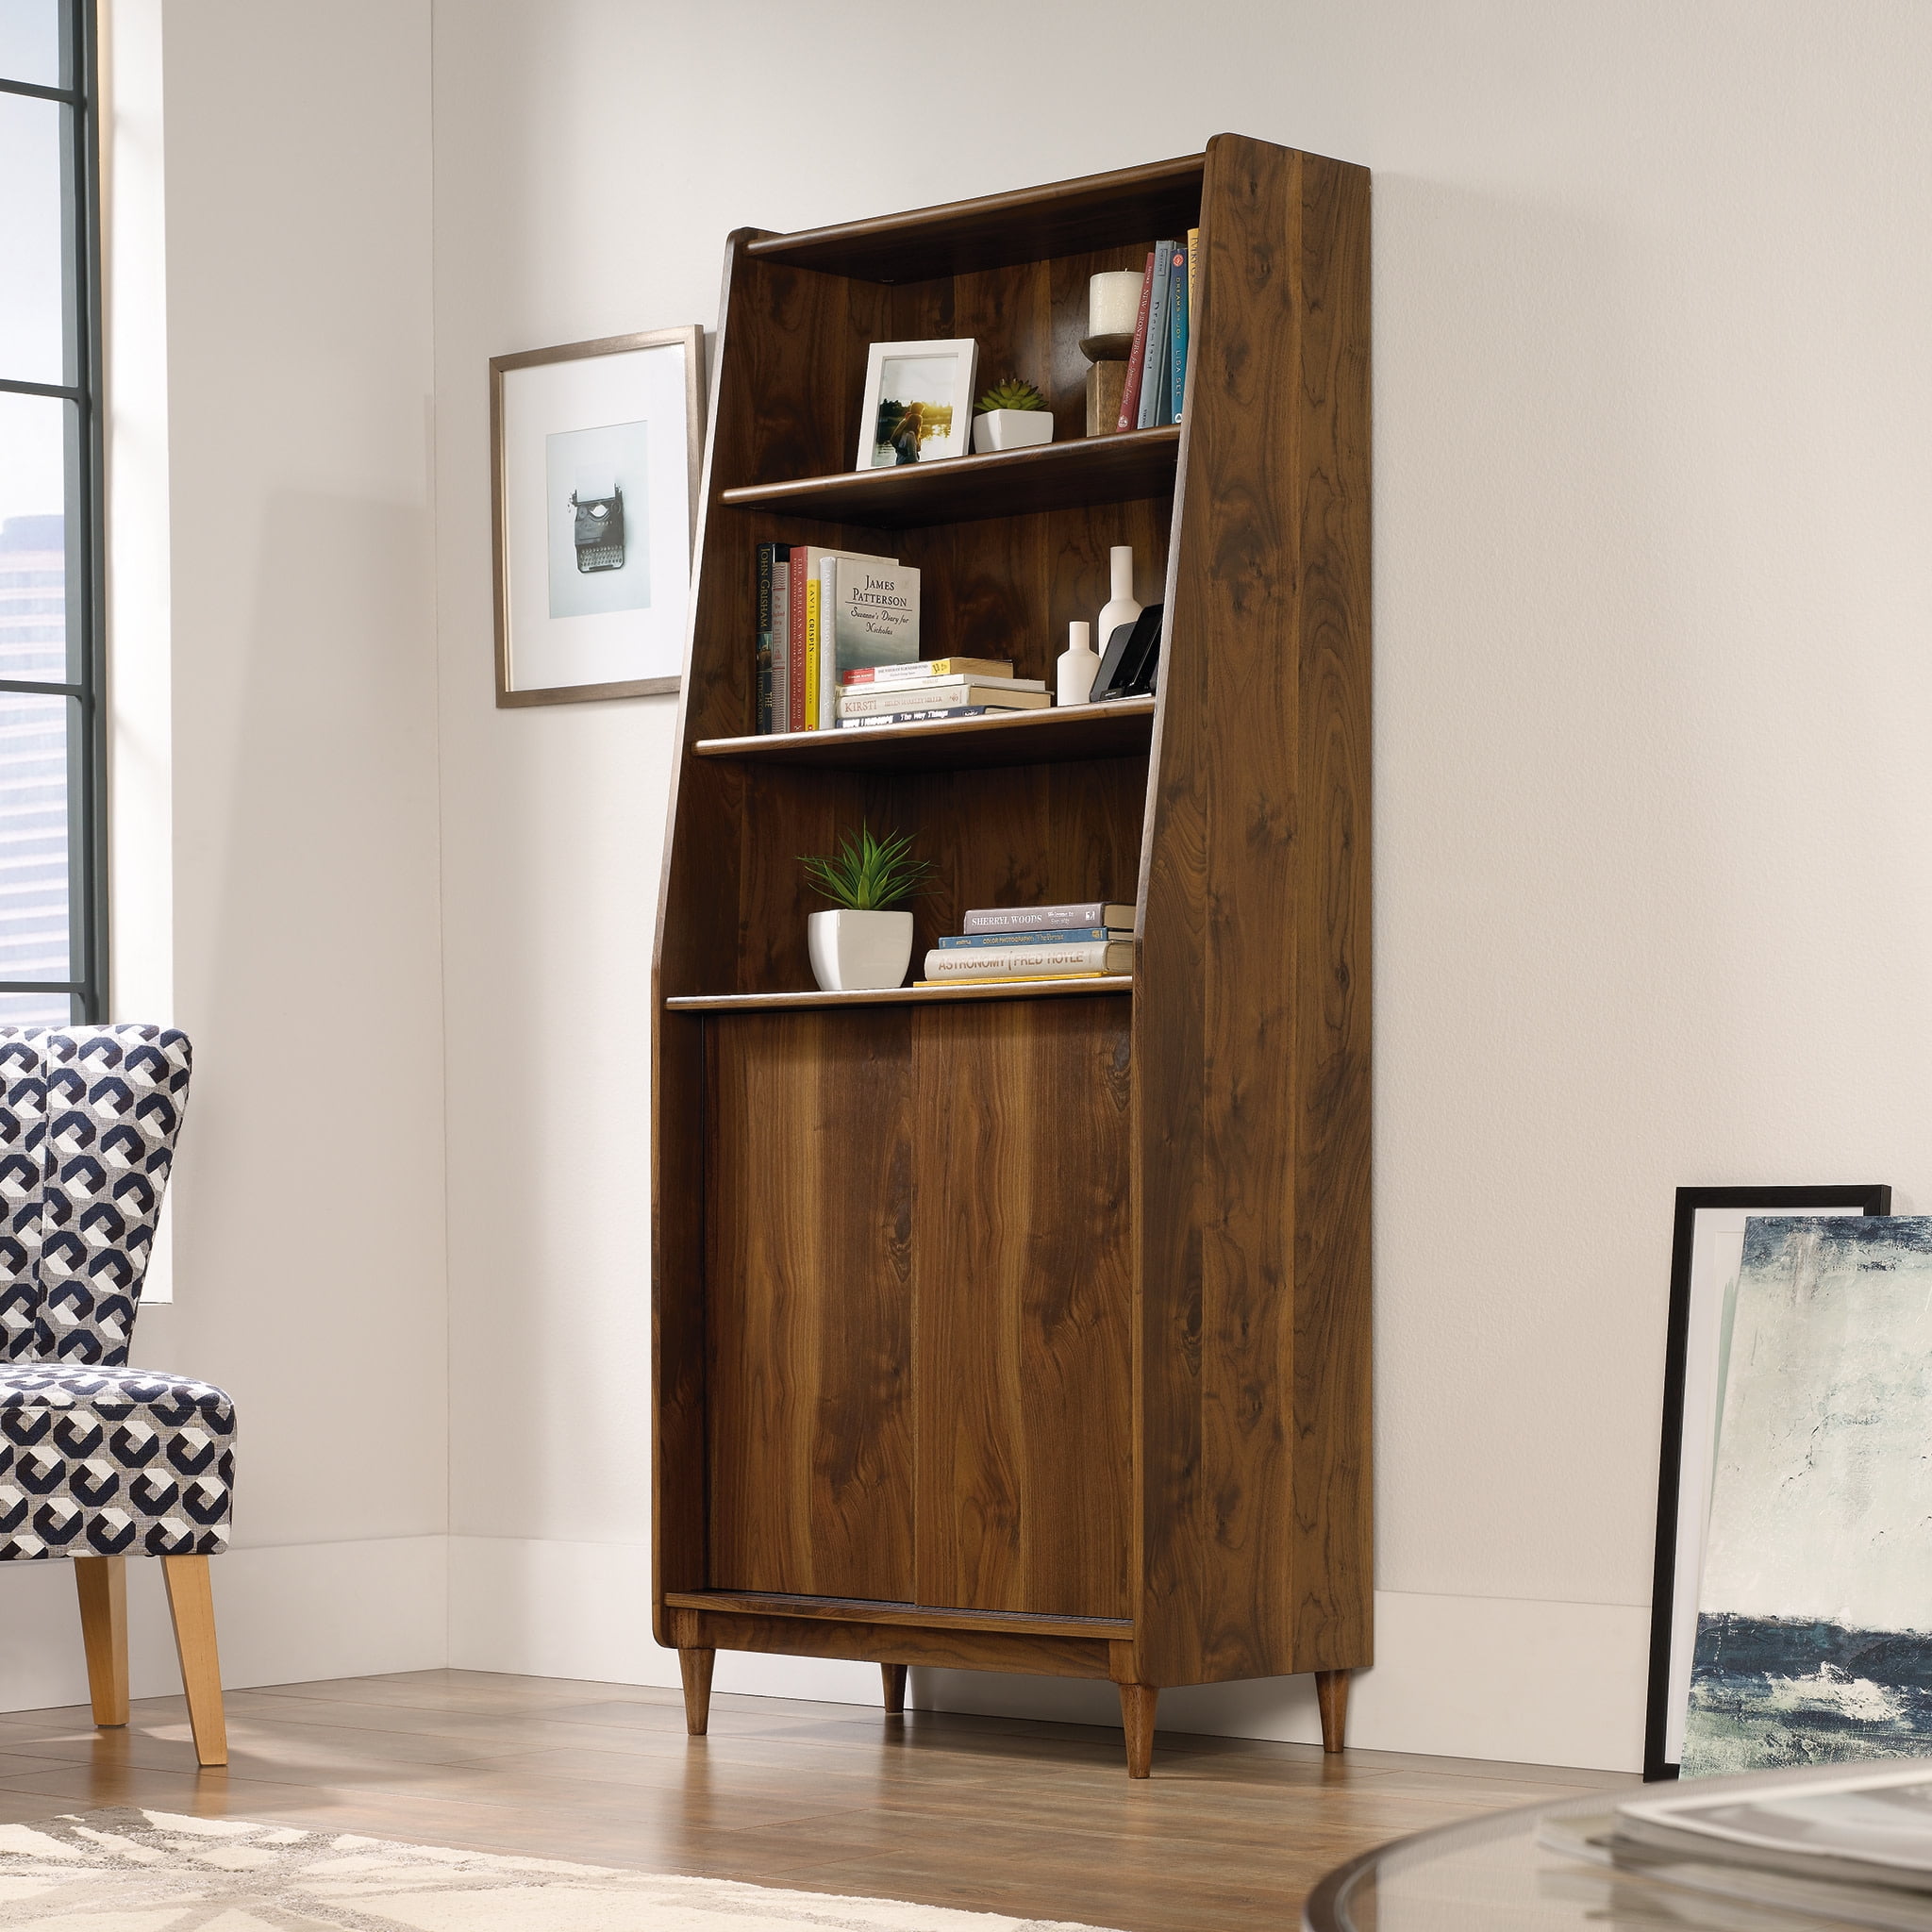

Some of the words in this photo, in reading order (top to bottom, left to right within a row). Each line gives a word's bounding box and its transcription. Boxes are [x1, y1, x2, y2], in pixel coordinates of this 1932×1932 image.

[1133, 311, 1145, 355] FRONTIERS
[760, 548, 771, 575] JOHN
[865, 575, 895, 591] JAMES
[760, 579, 771, 627] GRISHAM
[853, 588, 907, 607] PATTERSON
[845, 700, 877, 713] KIRSTI
[900, 712, 912, 722] The
[972, 916, 1009, 926] SHERRYL
[1011, 914, 1042, 924] WOODS
[939, 958, 1006, 971] ASTRONOMY
[1014, 953, 1042, 966] FRED
[1047, 951, 1084, 964] HOYLE
